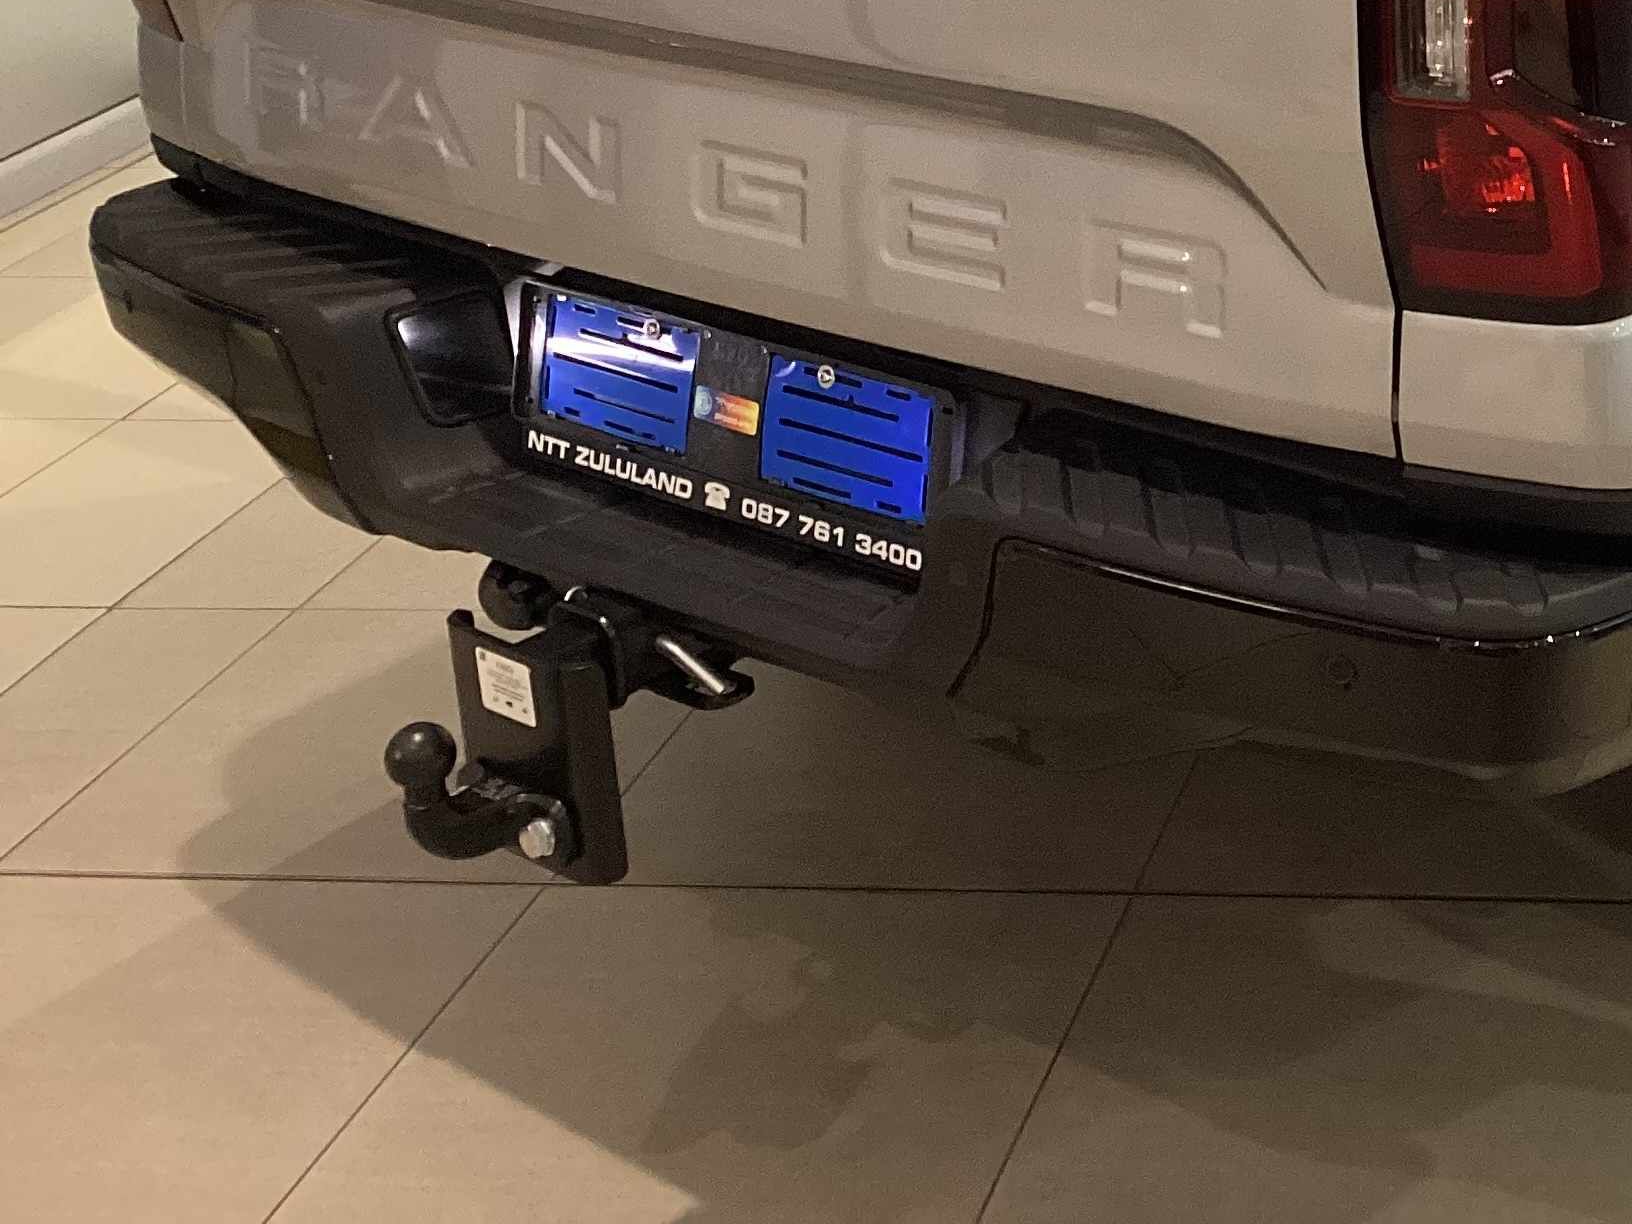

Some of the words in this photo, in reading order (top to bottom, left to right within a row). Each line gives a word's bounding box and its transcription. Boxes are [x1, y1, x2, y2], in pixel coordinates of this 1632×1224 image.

[245, 40, 1228, 339] RANGER
[527, 429, 571, 460] NTT
[574, 445, 693, 500] ZULULAND
[741, 497, 790, 528] 087
[798, 514, 845, 548] 761
[854, 533, 922, 572] 3400
